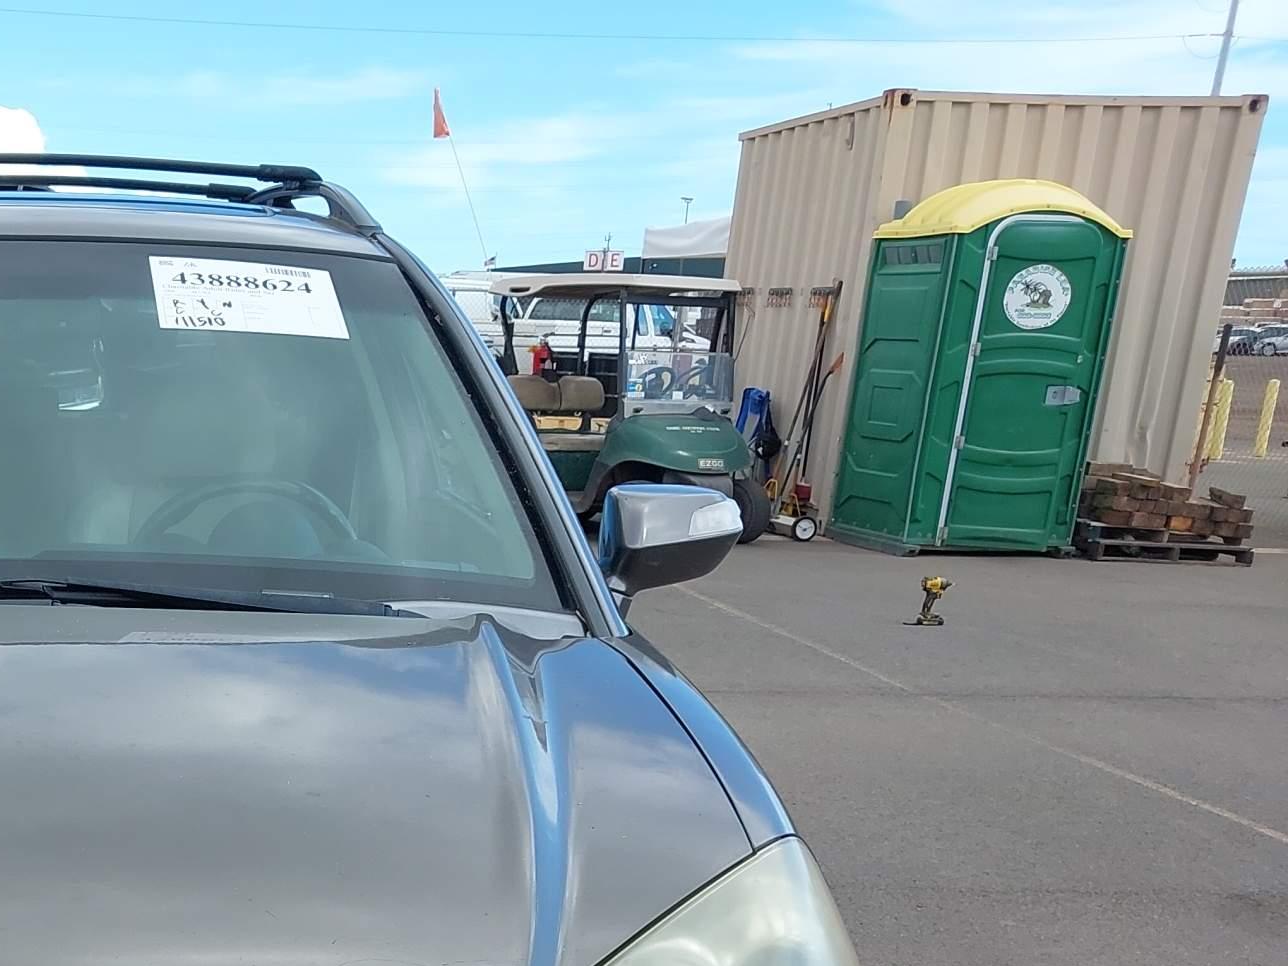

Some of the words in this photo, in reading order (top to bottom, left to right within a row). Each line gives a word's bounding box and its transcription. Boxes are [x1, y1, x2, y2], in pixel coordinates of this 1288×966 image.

[588, 252, 599, 268] D
[610, 252, 621, 268] E
[171, 271, 313, 294] 43888624
